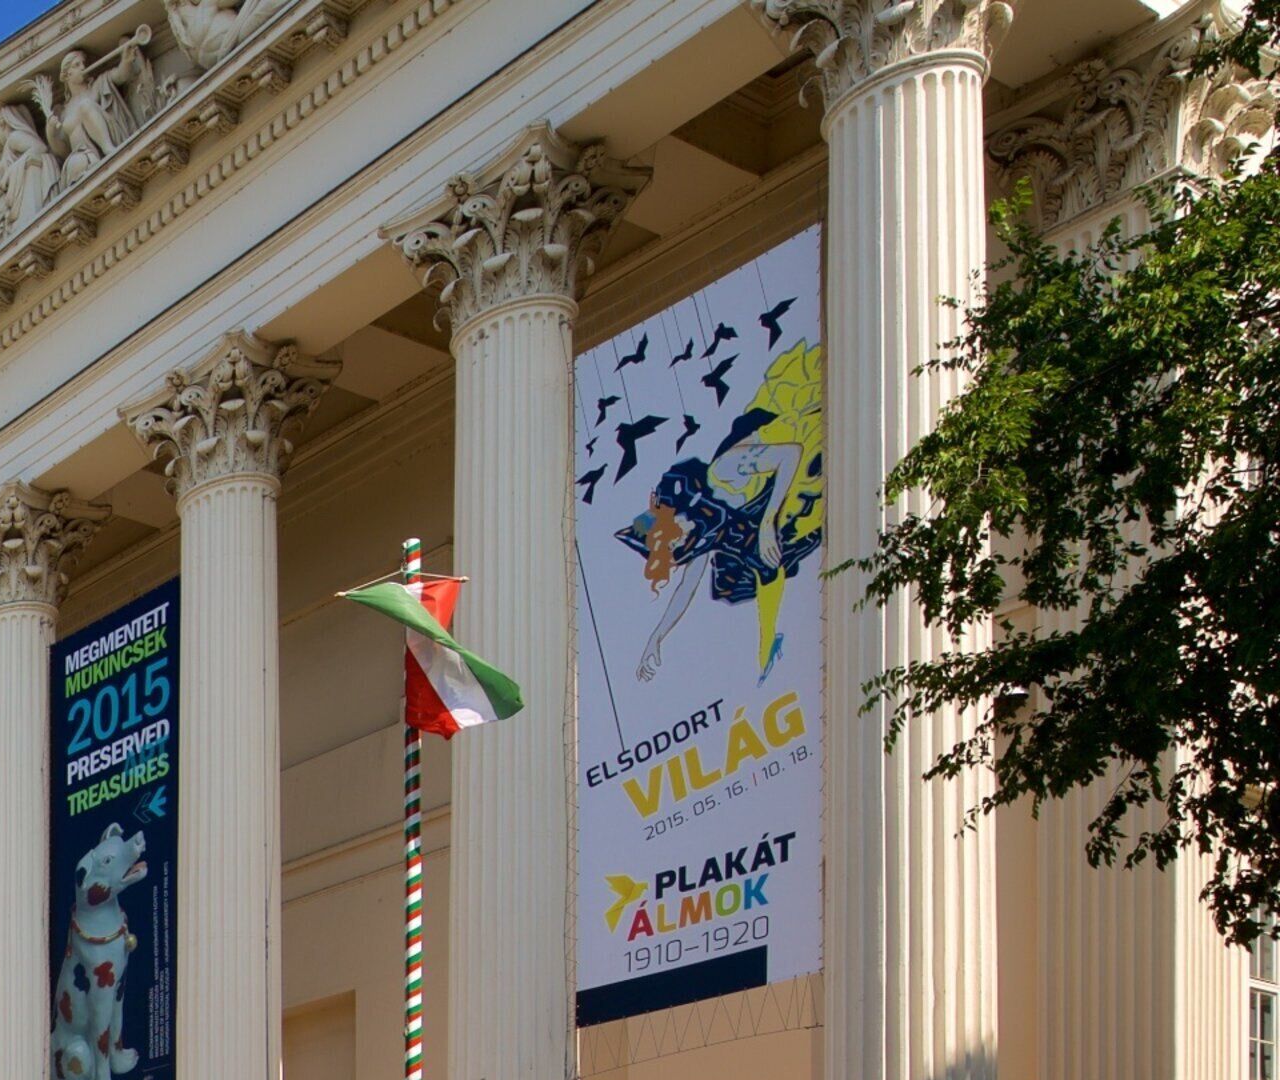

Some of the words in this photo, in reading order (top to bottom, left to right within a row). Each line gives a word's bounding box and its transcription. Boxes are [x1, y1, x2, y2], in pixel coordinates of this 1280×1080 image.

[65, 602, 170, 675] MEGMENTETT
[66, 657, 170, 755] 2015
[66, 718, 170, 786] PRESERVED
[585, 698, 725, 788] ELSODORT
[622, 690, 806, 819] VILÁG
[66, 752, 170, 817] TREASURES
[643, 813, 689, 841] 2015.
[692, 794, 721, 818] 05.
[725, 780, 749, 801] 16.
[761, 760, 786, 781] 10.
[788, 745, 814, 766] 18.
[655, 831, 797, 900] PLAKÁT
[627, 872, 769, 942] ÁLMOK
